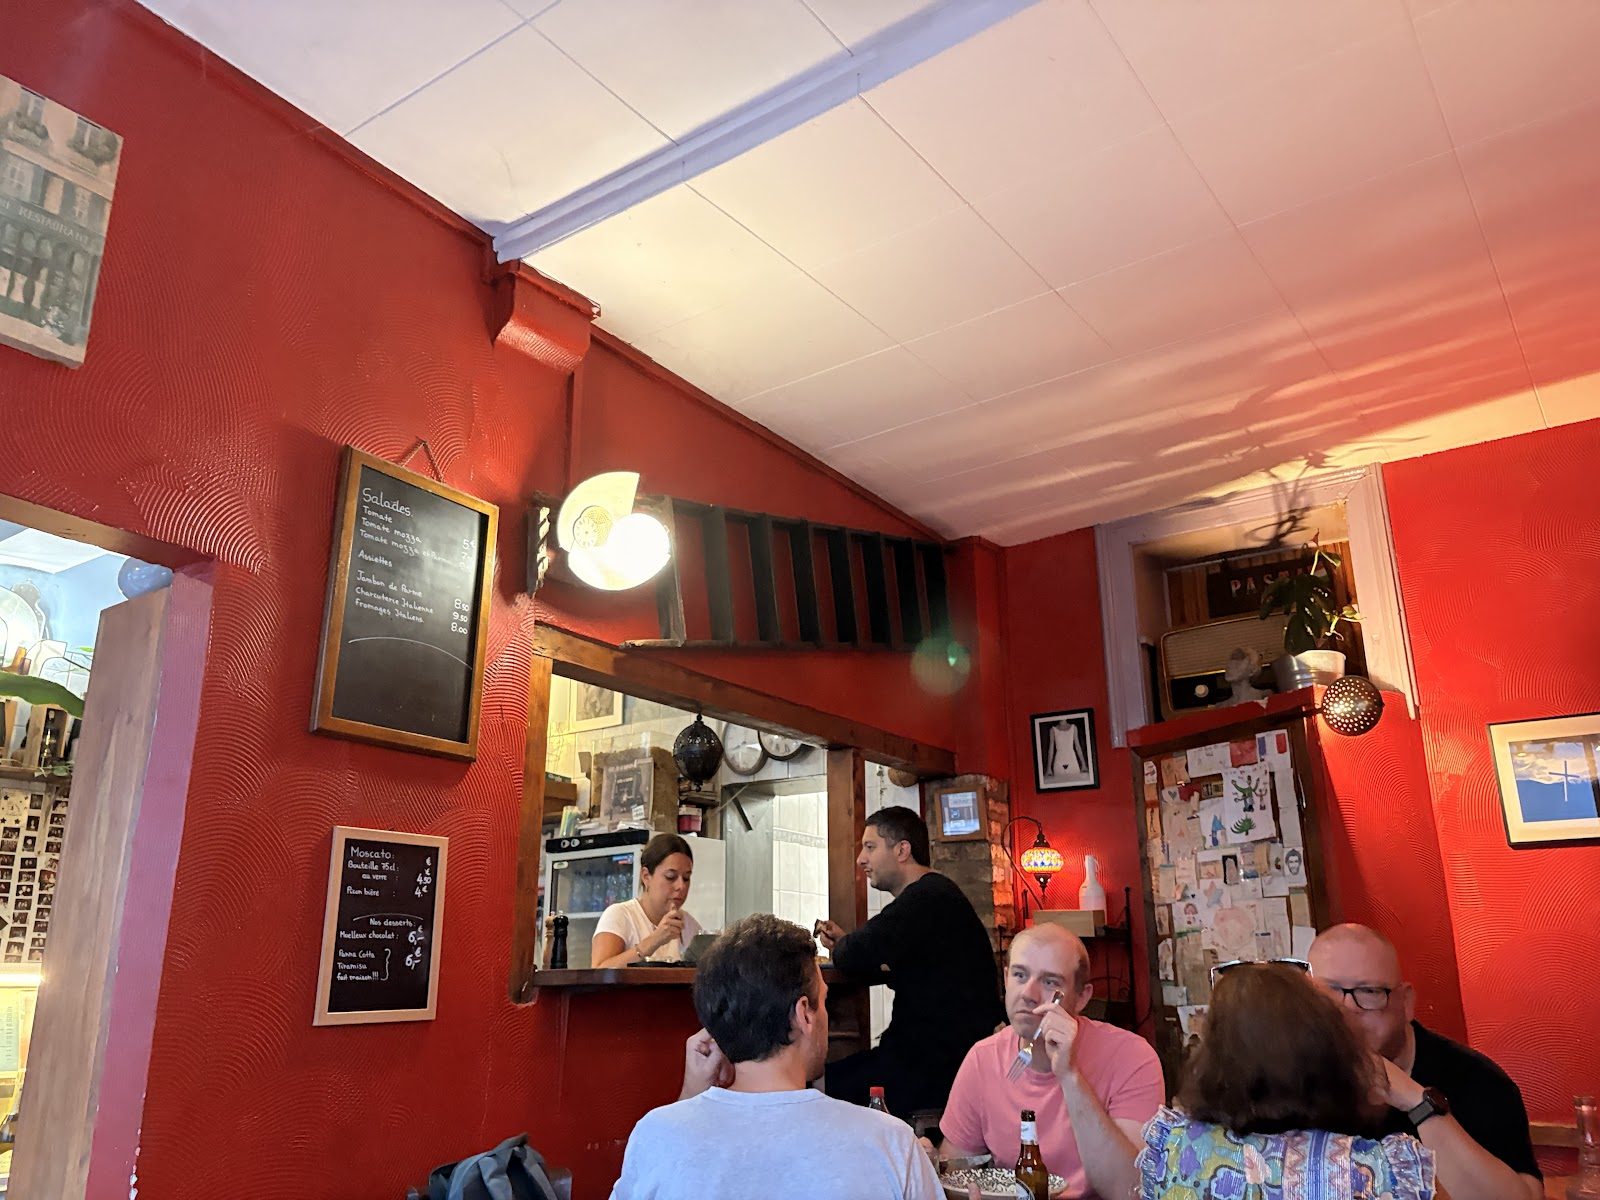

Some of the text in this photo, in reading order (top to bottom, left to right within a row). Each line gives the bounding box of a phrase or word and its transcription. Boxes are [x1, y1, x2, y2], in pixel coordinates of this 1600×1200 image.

[362, 505, 393, 523] Tomate
[361, 517, 422, 545] Tomate mozza
[359, 529, 388, 545] Tomate
[391, 541, 419, 557] mozza
[357, 549, 392, 568] Assiettes
[356, 569, 470, 612] Jambon de Parme 8.50
[355, 586, 468, 622] Charcuterie Italienne 9.50
[354, 598, 391, 616] Fromages
[450, 622, 468, 635] 8.00
[347, 859, 379, 871] Bouteille
[369, 918, 382, 926] Nos
[339, 930, 367, 939] Moelleux
[338, 949, 357, 958] Panna
[358, 949, 376, 959] Cotta
[337, 962, 368, 970] Tiramisu
[336, 972, 348, 981] fait
